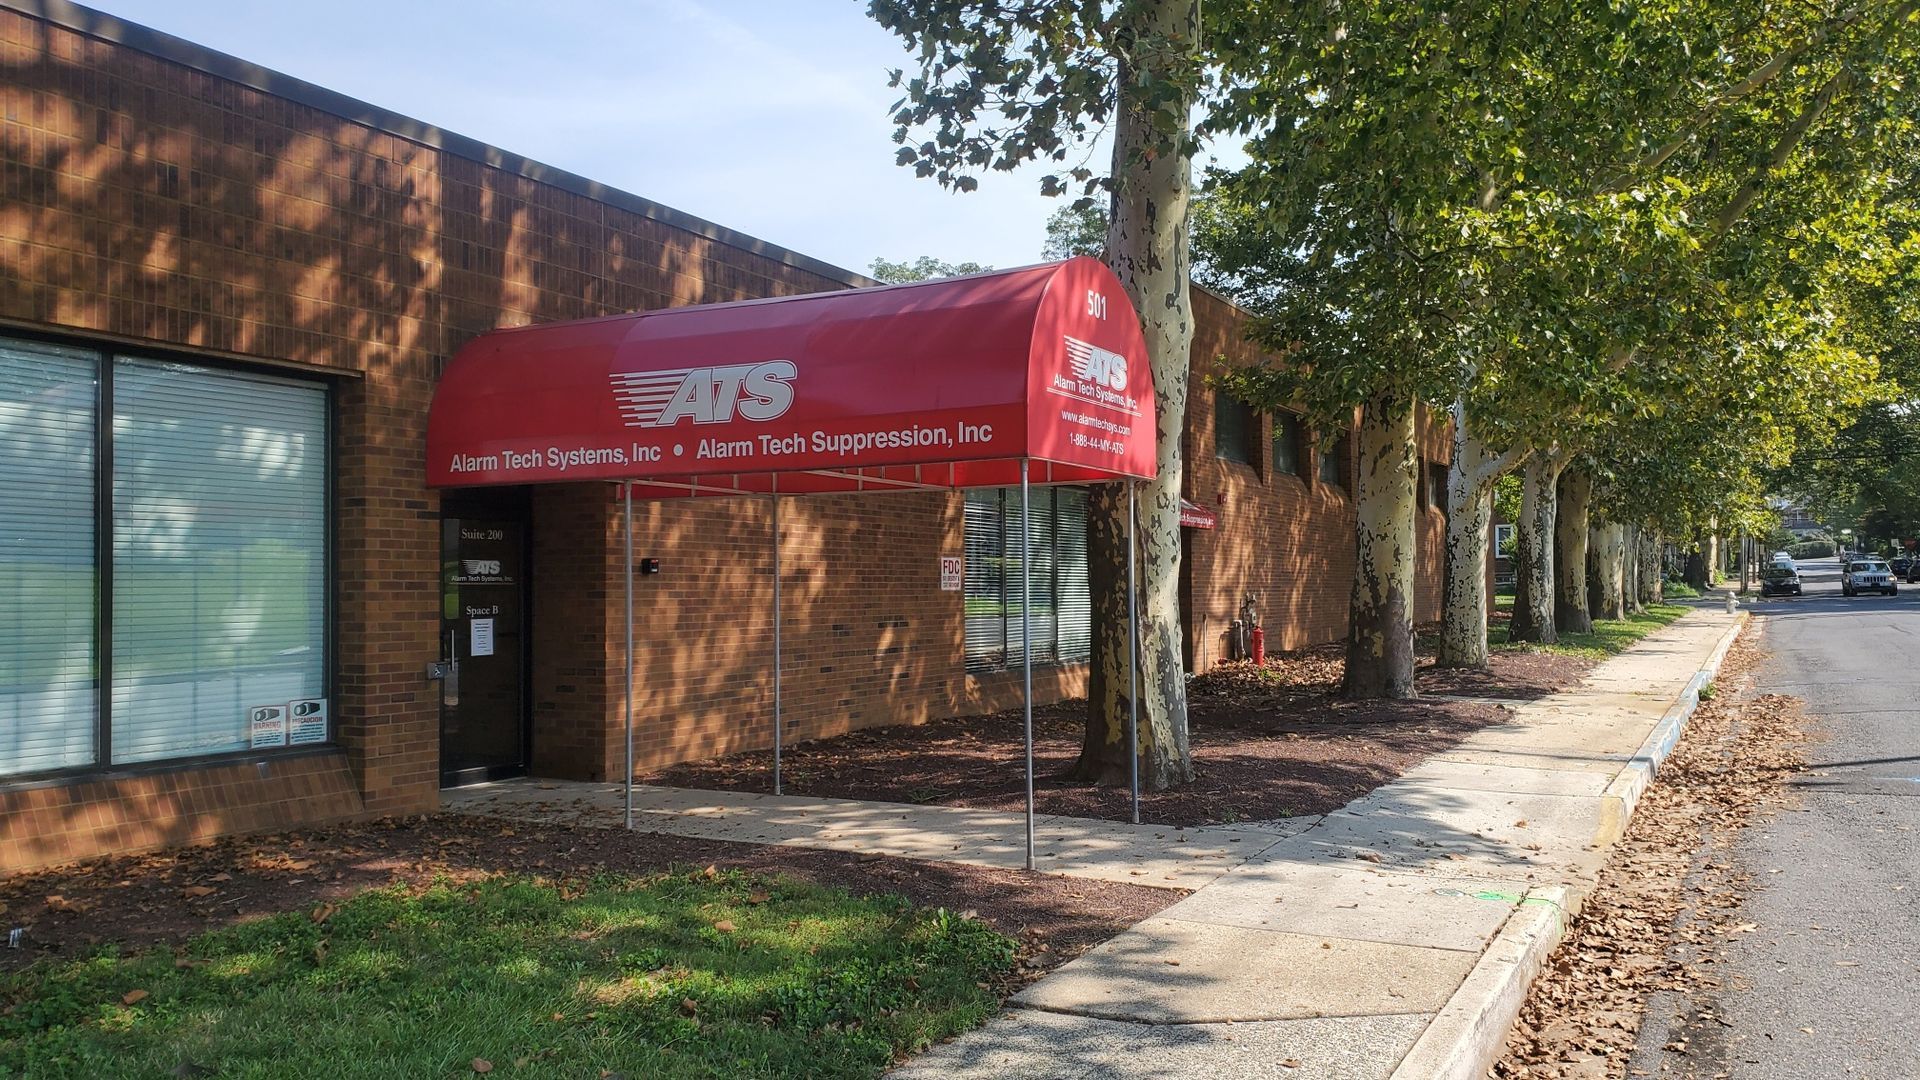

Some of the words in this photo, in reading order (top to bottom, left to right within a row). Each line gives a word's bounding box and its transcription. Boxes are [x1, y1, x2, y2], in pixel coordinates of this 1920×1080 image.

[1088, 290, 1107, 320] 501
[1084, 346, 1128, 391] ATS
[656, 360, 797, 425] ATS
[1054, 373, 1076, 392] Alarm
[1077, 380, 1095, 397] Tech
[1096, 386, 1126, 407] Systems,
[1061, 410, 1131, 436] www.alarmtechsys.com
[696, 439, 753, 459] Alarm
[758, 433, 806, 456] Tech
[811, 425, 953, 456] Suppression,
[958, 421, 993, 443] Inc
[450, 454, 498, 473] Alarm
[502, 449, 542, 469] Tech
[547, 446, 629, 471] Systems,
[633, 442, 661, 462] Inc
[461, 528, 485, 540] Suite
[487, 529, 503, 541] 200
[474, 560, 501, 575] ATS
[943, 560, 960, 574] FDC
[466, 605, 491, 617] Space
[492, 605, 499, 614] B
